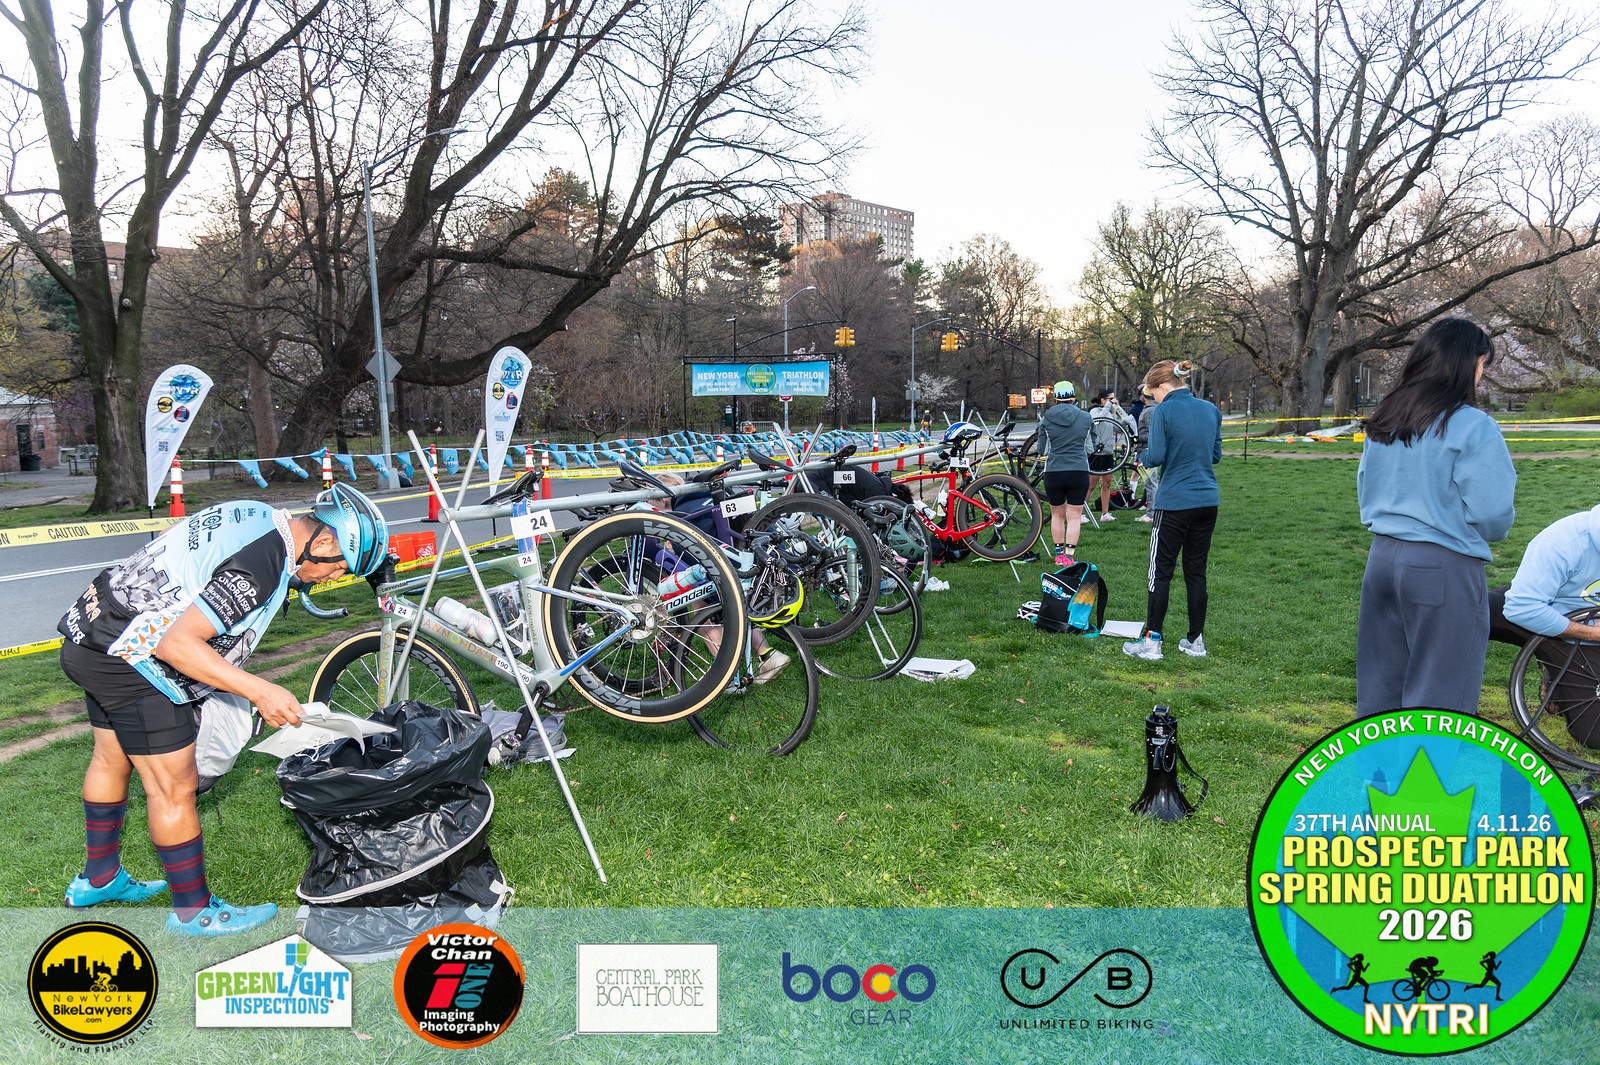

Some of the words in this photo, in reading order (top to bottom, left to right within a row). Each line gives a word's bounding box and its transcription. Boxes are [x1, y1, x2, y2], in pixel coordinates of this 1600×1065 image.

[697, 372, 716, 380] NEW
[717, 371, 740, 379] YORK
[781, 371, 824, 380] TRIATHLON
[842, 473, 852, 481] 66
[725, 503, 737, 513] 63
[100, 521, 140, 534] CAUTION
[530, 515, 548, 531] 24
[47, 525, 90, 540] CAUTION
[522, 556, 532, 564] 24
[230, 574, 257, 597] TOP
[381, 581, 408, 592] cannondale
[218, 576, 251, 613] UNDRAISER
[665, 584, 713, 610] nondale
[206, 584, 235, 617] Bloomberg
[398, 607, 407, 616] 24
[422, 617, 496, 665] ANNONDALE
[497, 660, 509, 670] 190
[520, 672, 530, 683] 90
